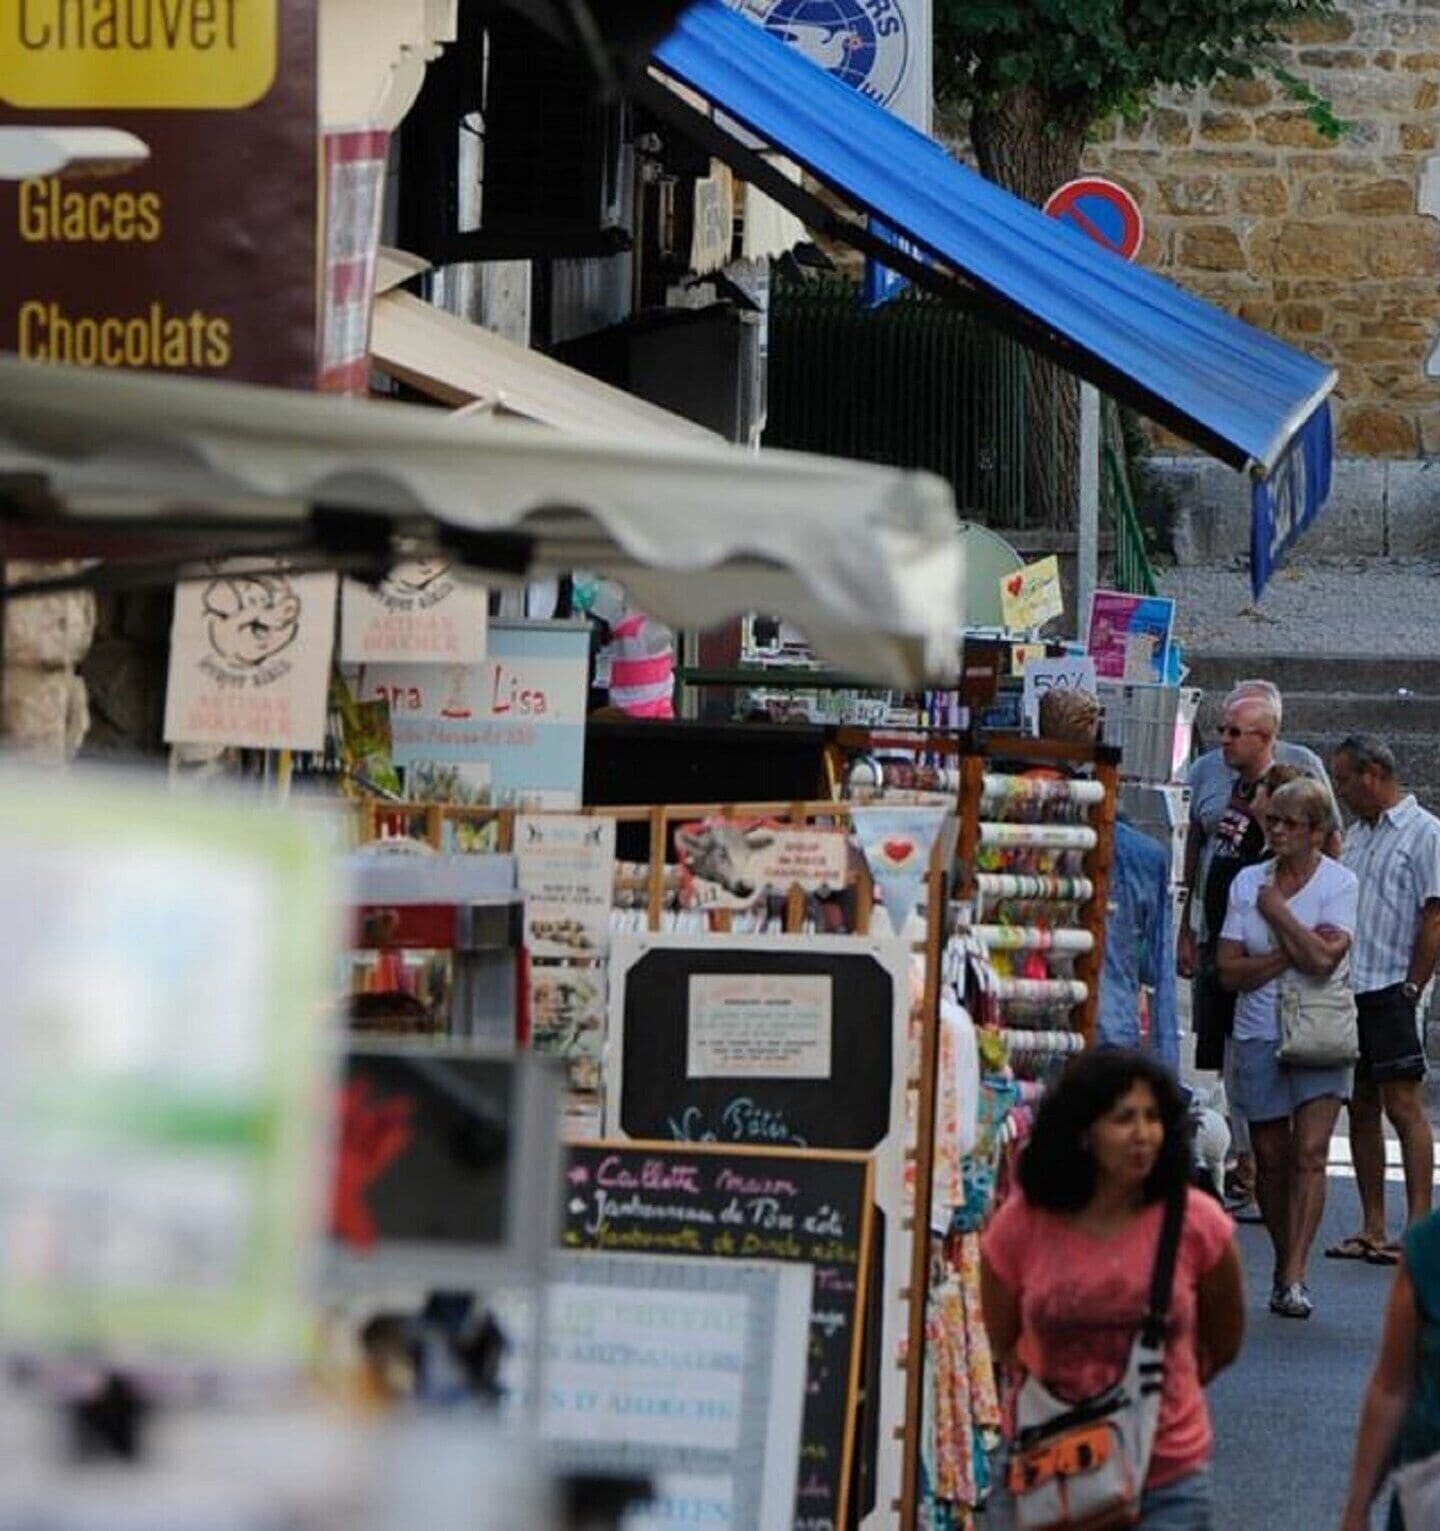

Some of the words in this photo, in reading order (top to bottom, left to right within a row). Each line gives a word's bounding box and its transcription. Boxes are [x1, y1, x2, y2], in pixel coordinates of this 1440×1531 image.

[18, 0, 238, 50] Chauvet
[19, 175, 161, 242] Glaces
[19, 301, 232, 367] Chocolats
[492, 664, 547, 714] Lisa
